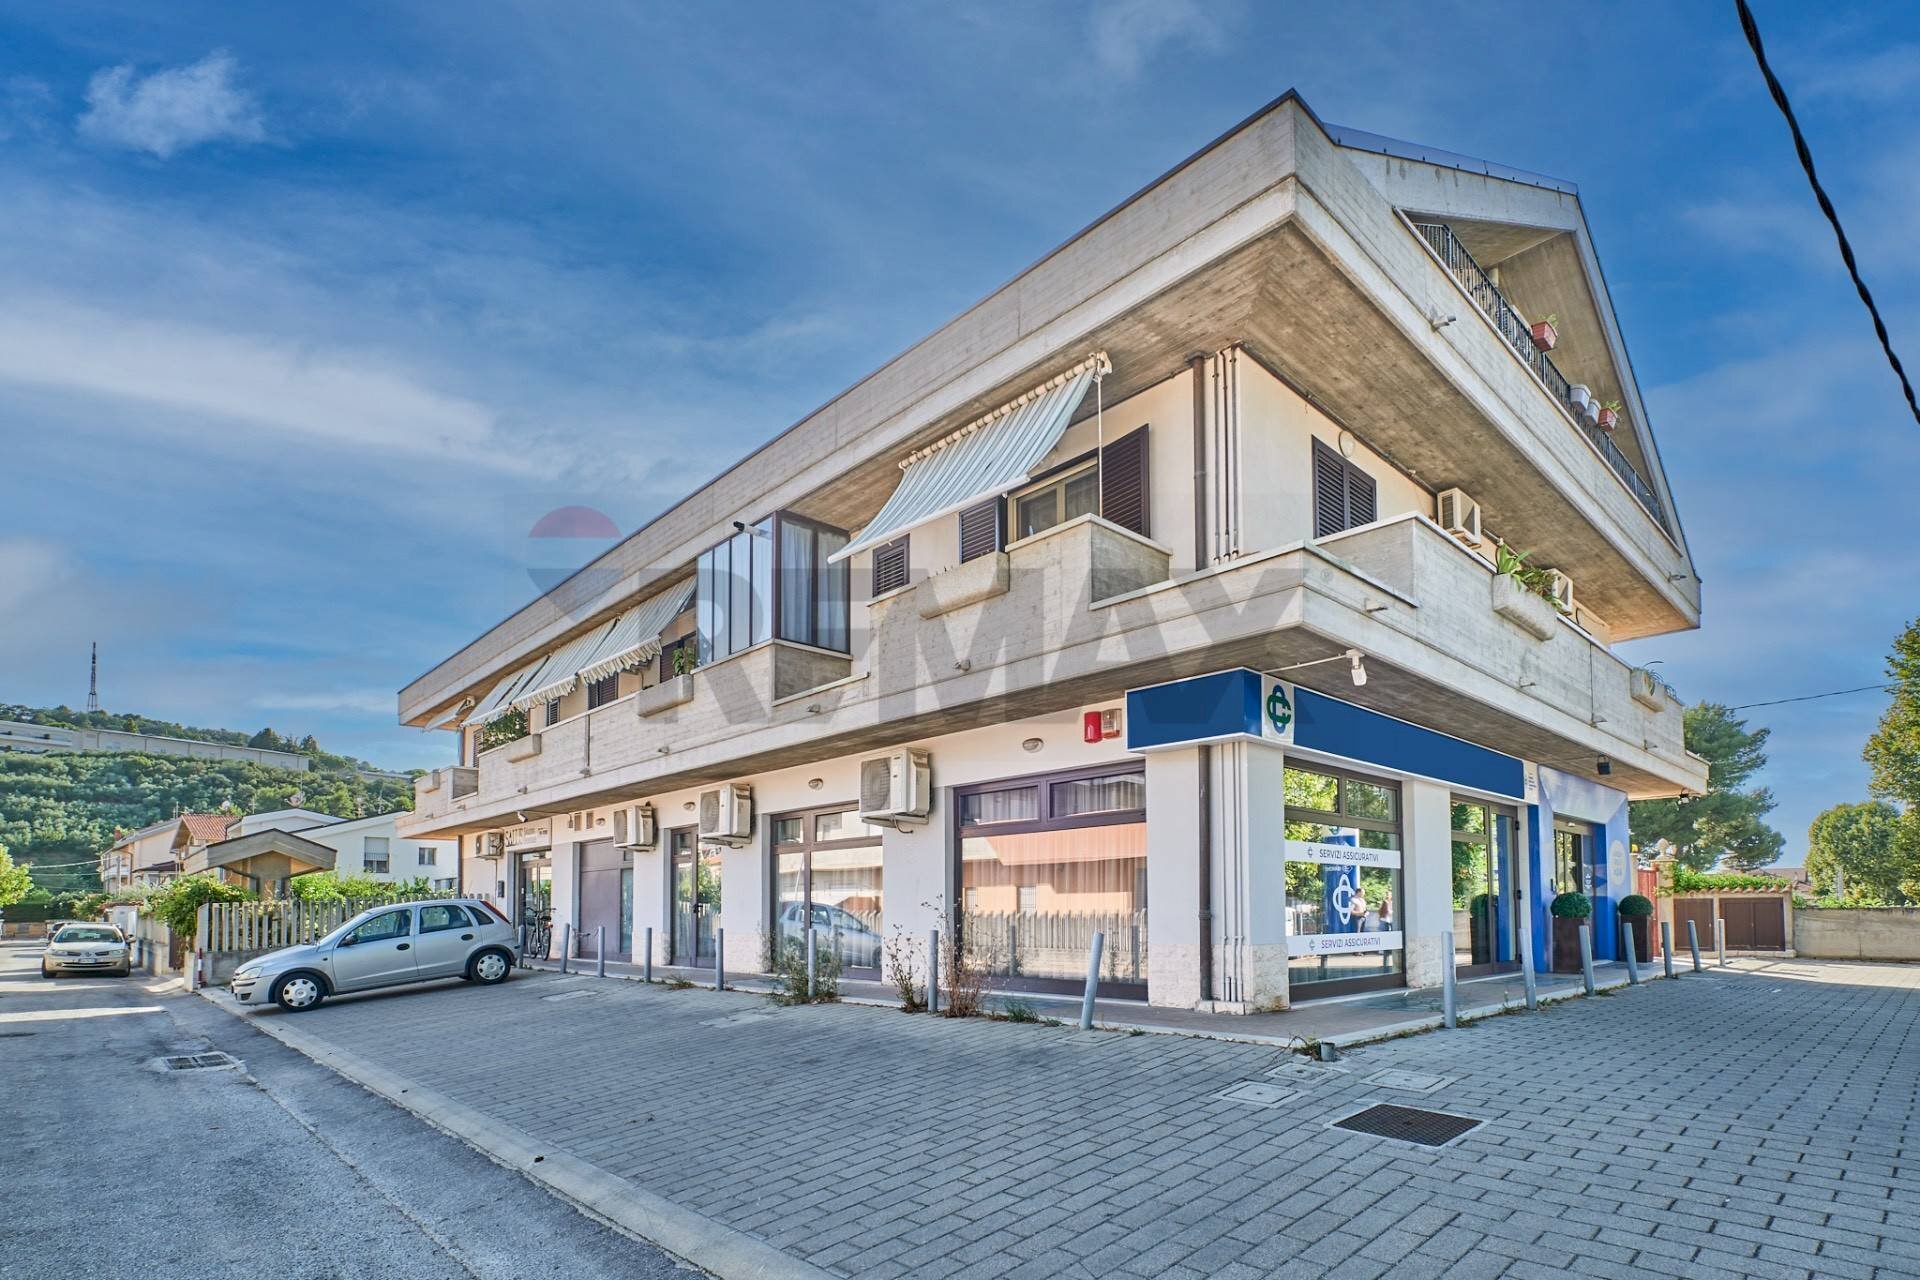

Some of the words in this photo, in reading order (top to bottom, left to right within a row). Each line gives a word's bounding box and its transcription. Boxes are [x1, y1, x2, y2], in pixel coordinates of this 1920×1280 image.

[1319, 848, 1341, 859] SERVIZI
[1343, 850, 1379, 862] ASSICURATIVI
[1321, 939, 1343, 949] SERVIZI
[1345, 937, 1381, 947] ASSICURATIVI
